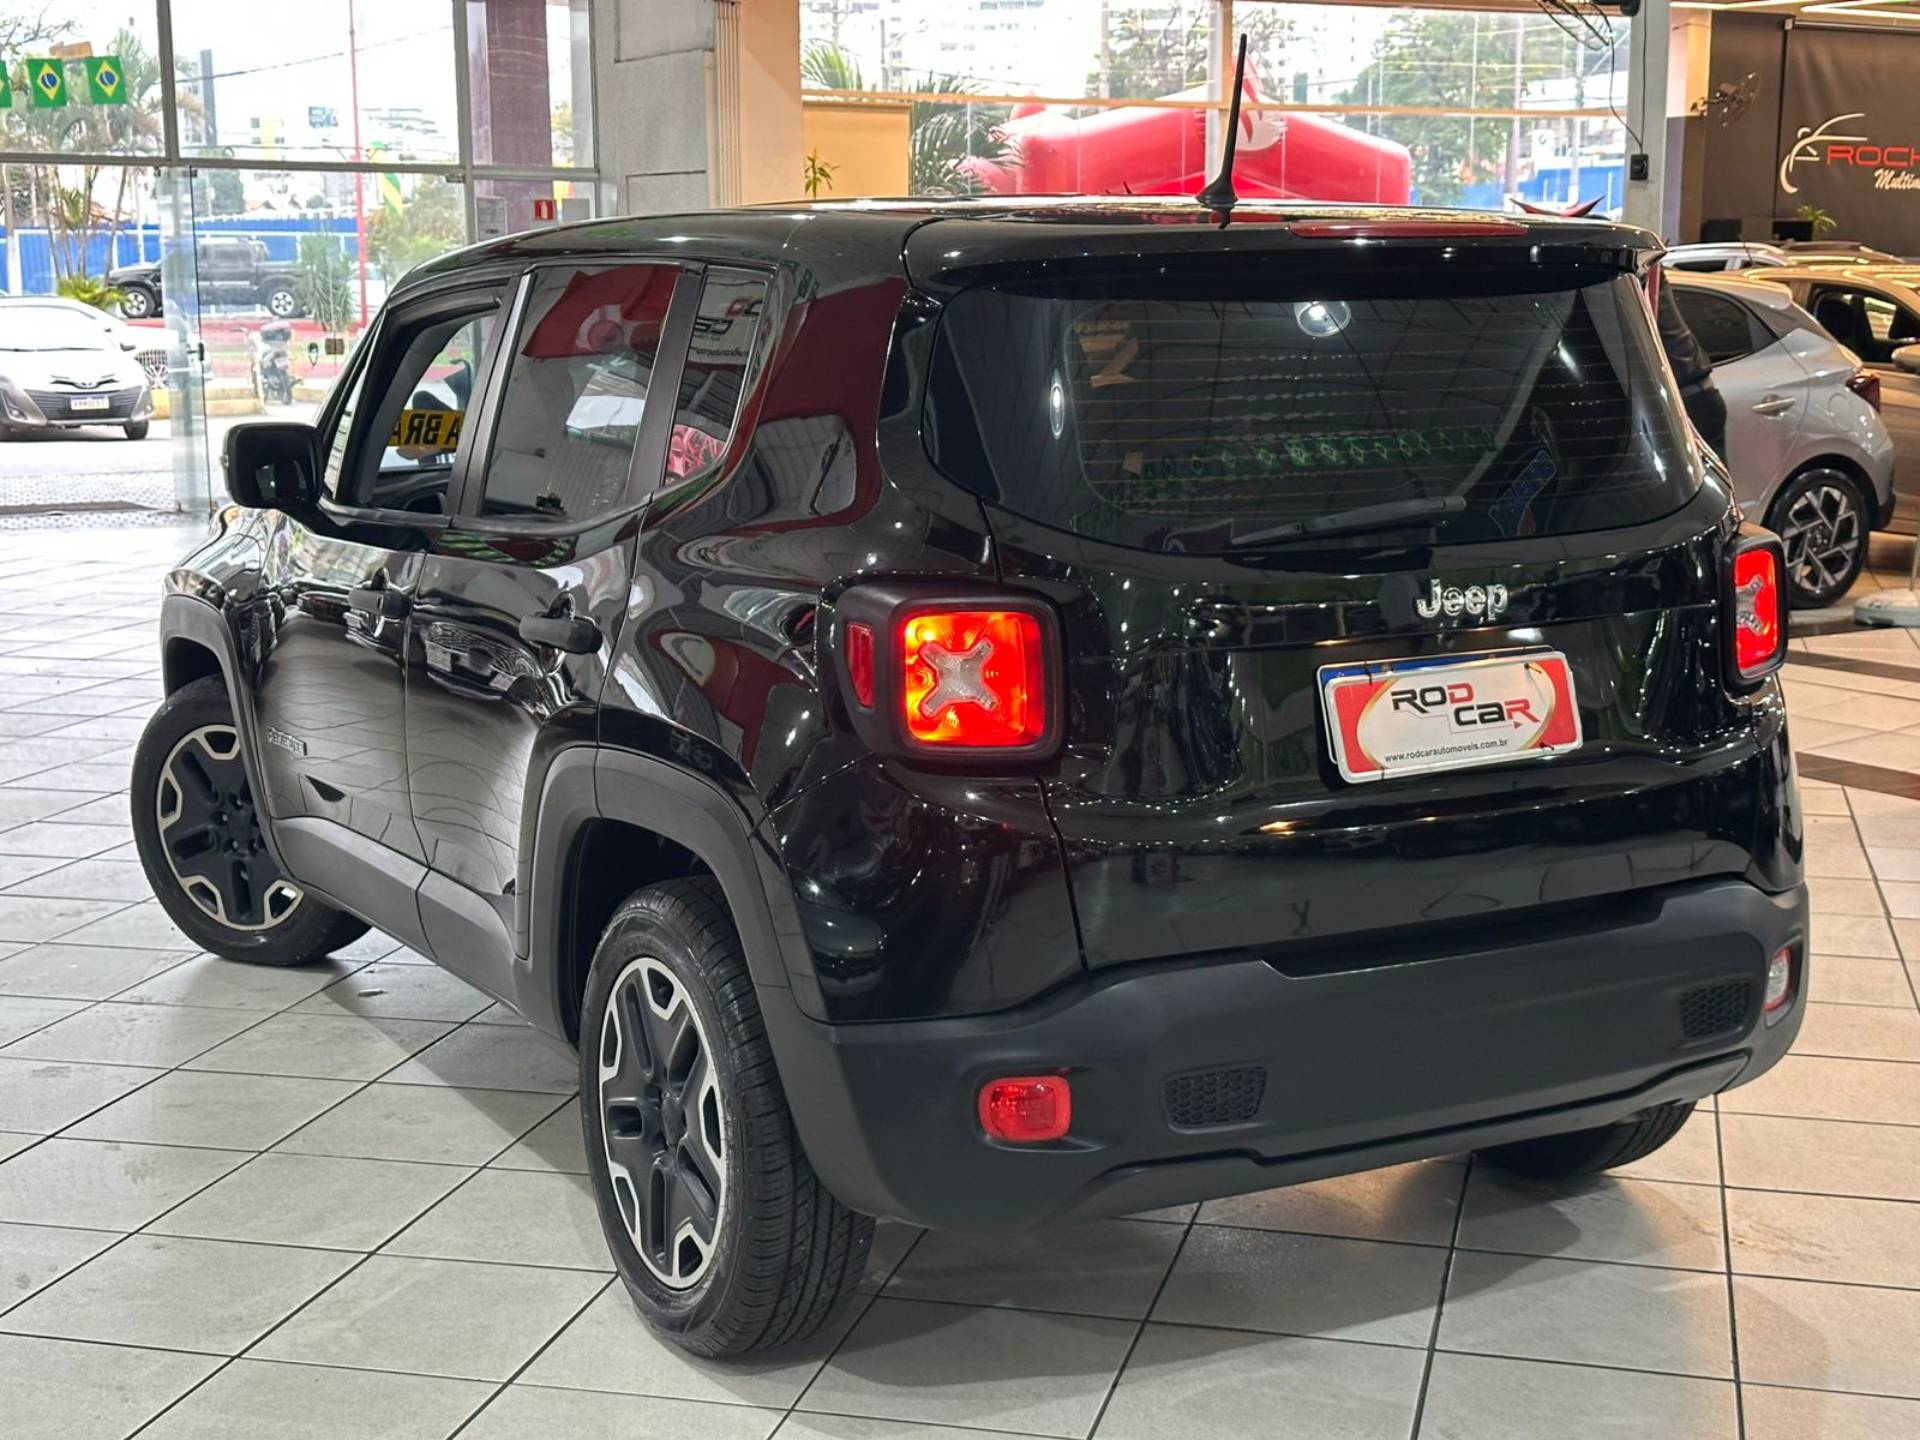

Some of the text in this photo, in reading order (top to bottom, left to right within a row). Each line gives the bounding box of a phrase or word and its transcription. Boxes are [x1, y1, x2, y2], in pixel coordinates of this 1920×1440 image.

[1416, 578, 1509, 620] Jeep
[1390, 682, 1474, 713] ROD
[1384, 738, 1509, 762] www.rodcarautomoveis.com.br
